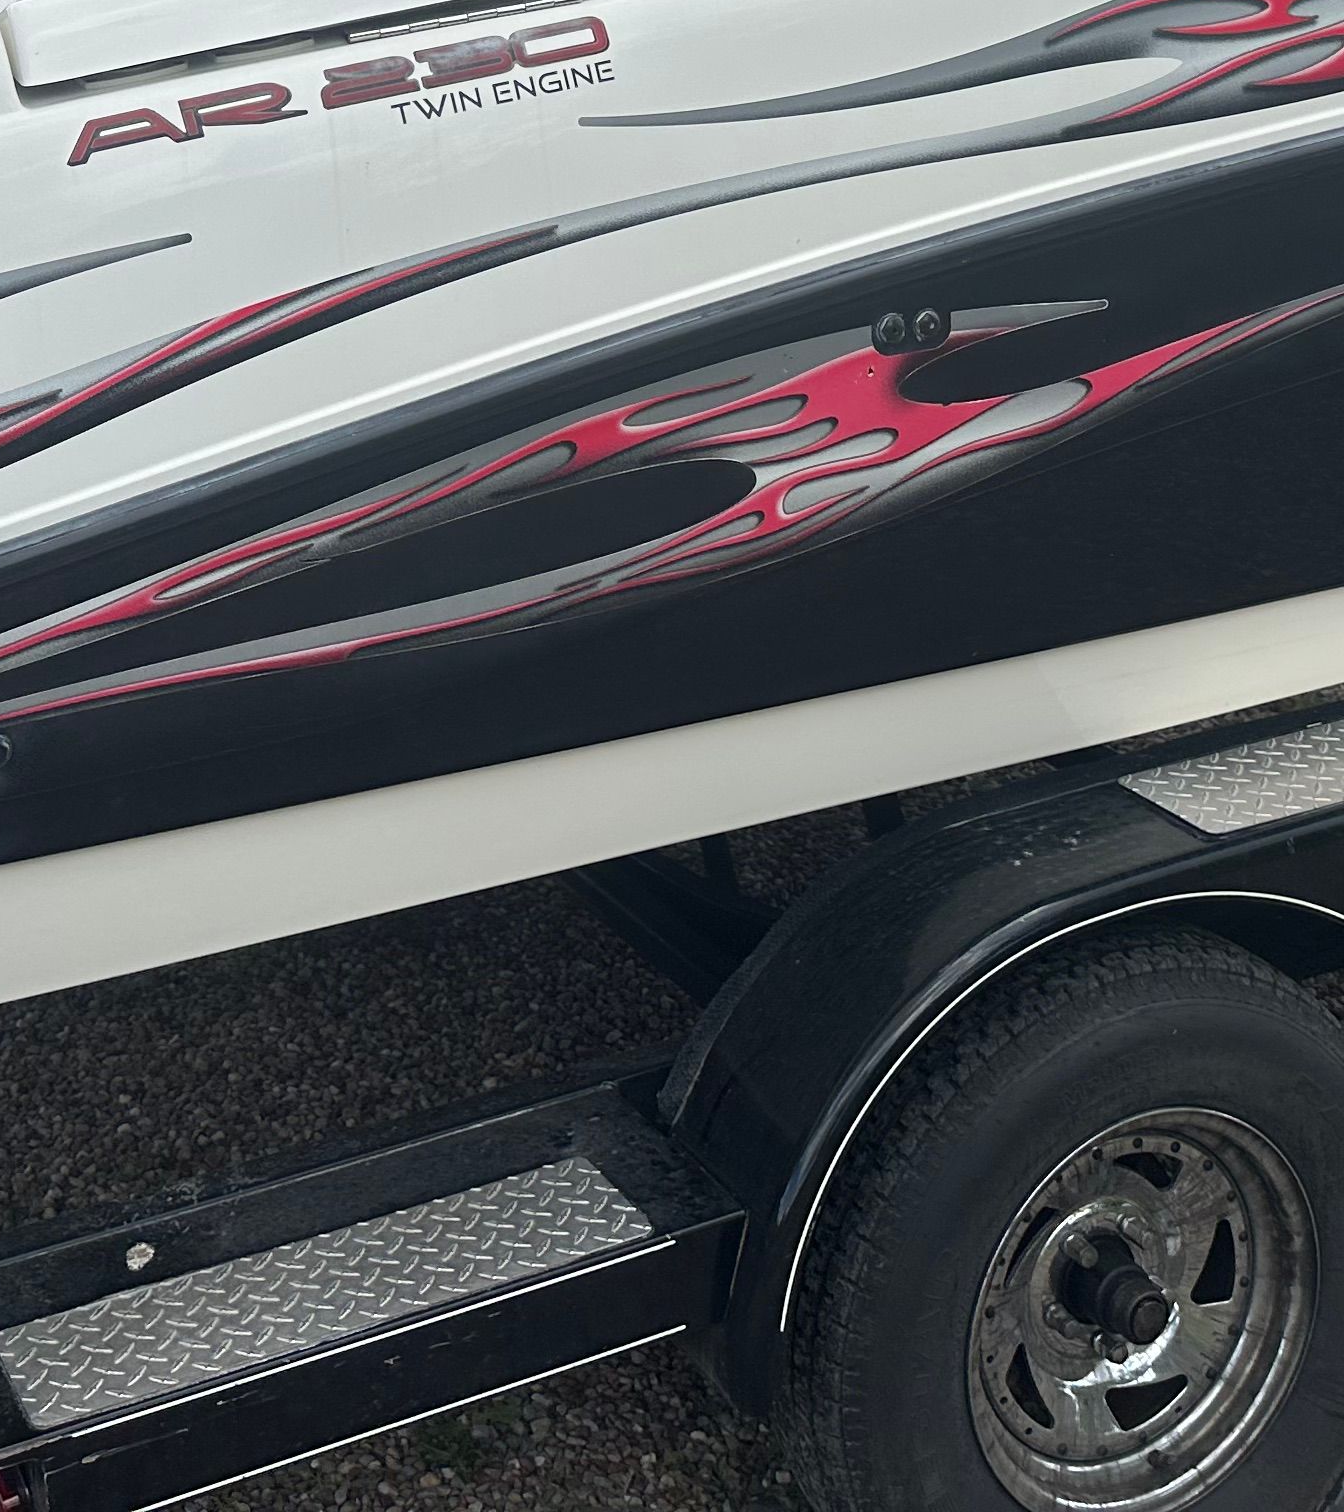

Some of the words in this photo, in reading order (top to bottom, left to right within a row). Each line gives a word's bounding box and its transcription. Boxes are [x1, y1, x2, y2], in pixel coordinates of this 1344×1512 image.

[67, 82, 309, 167] AR
[320, 15, 610, 110] 230
[390, 87, 483, 125] TWIN
[494, 59, 616, 106] ENGINE
